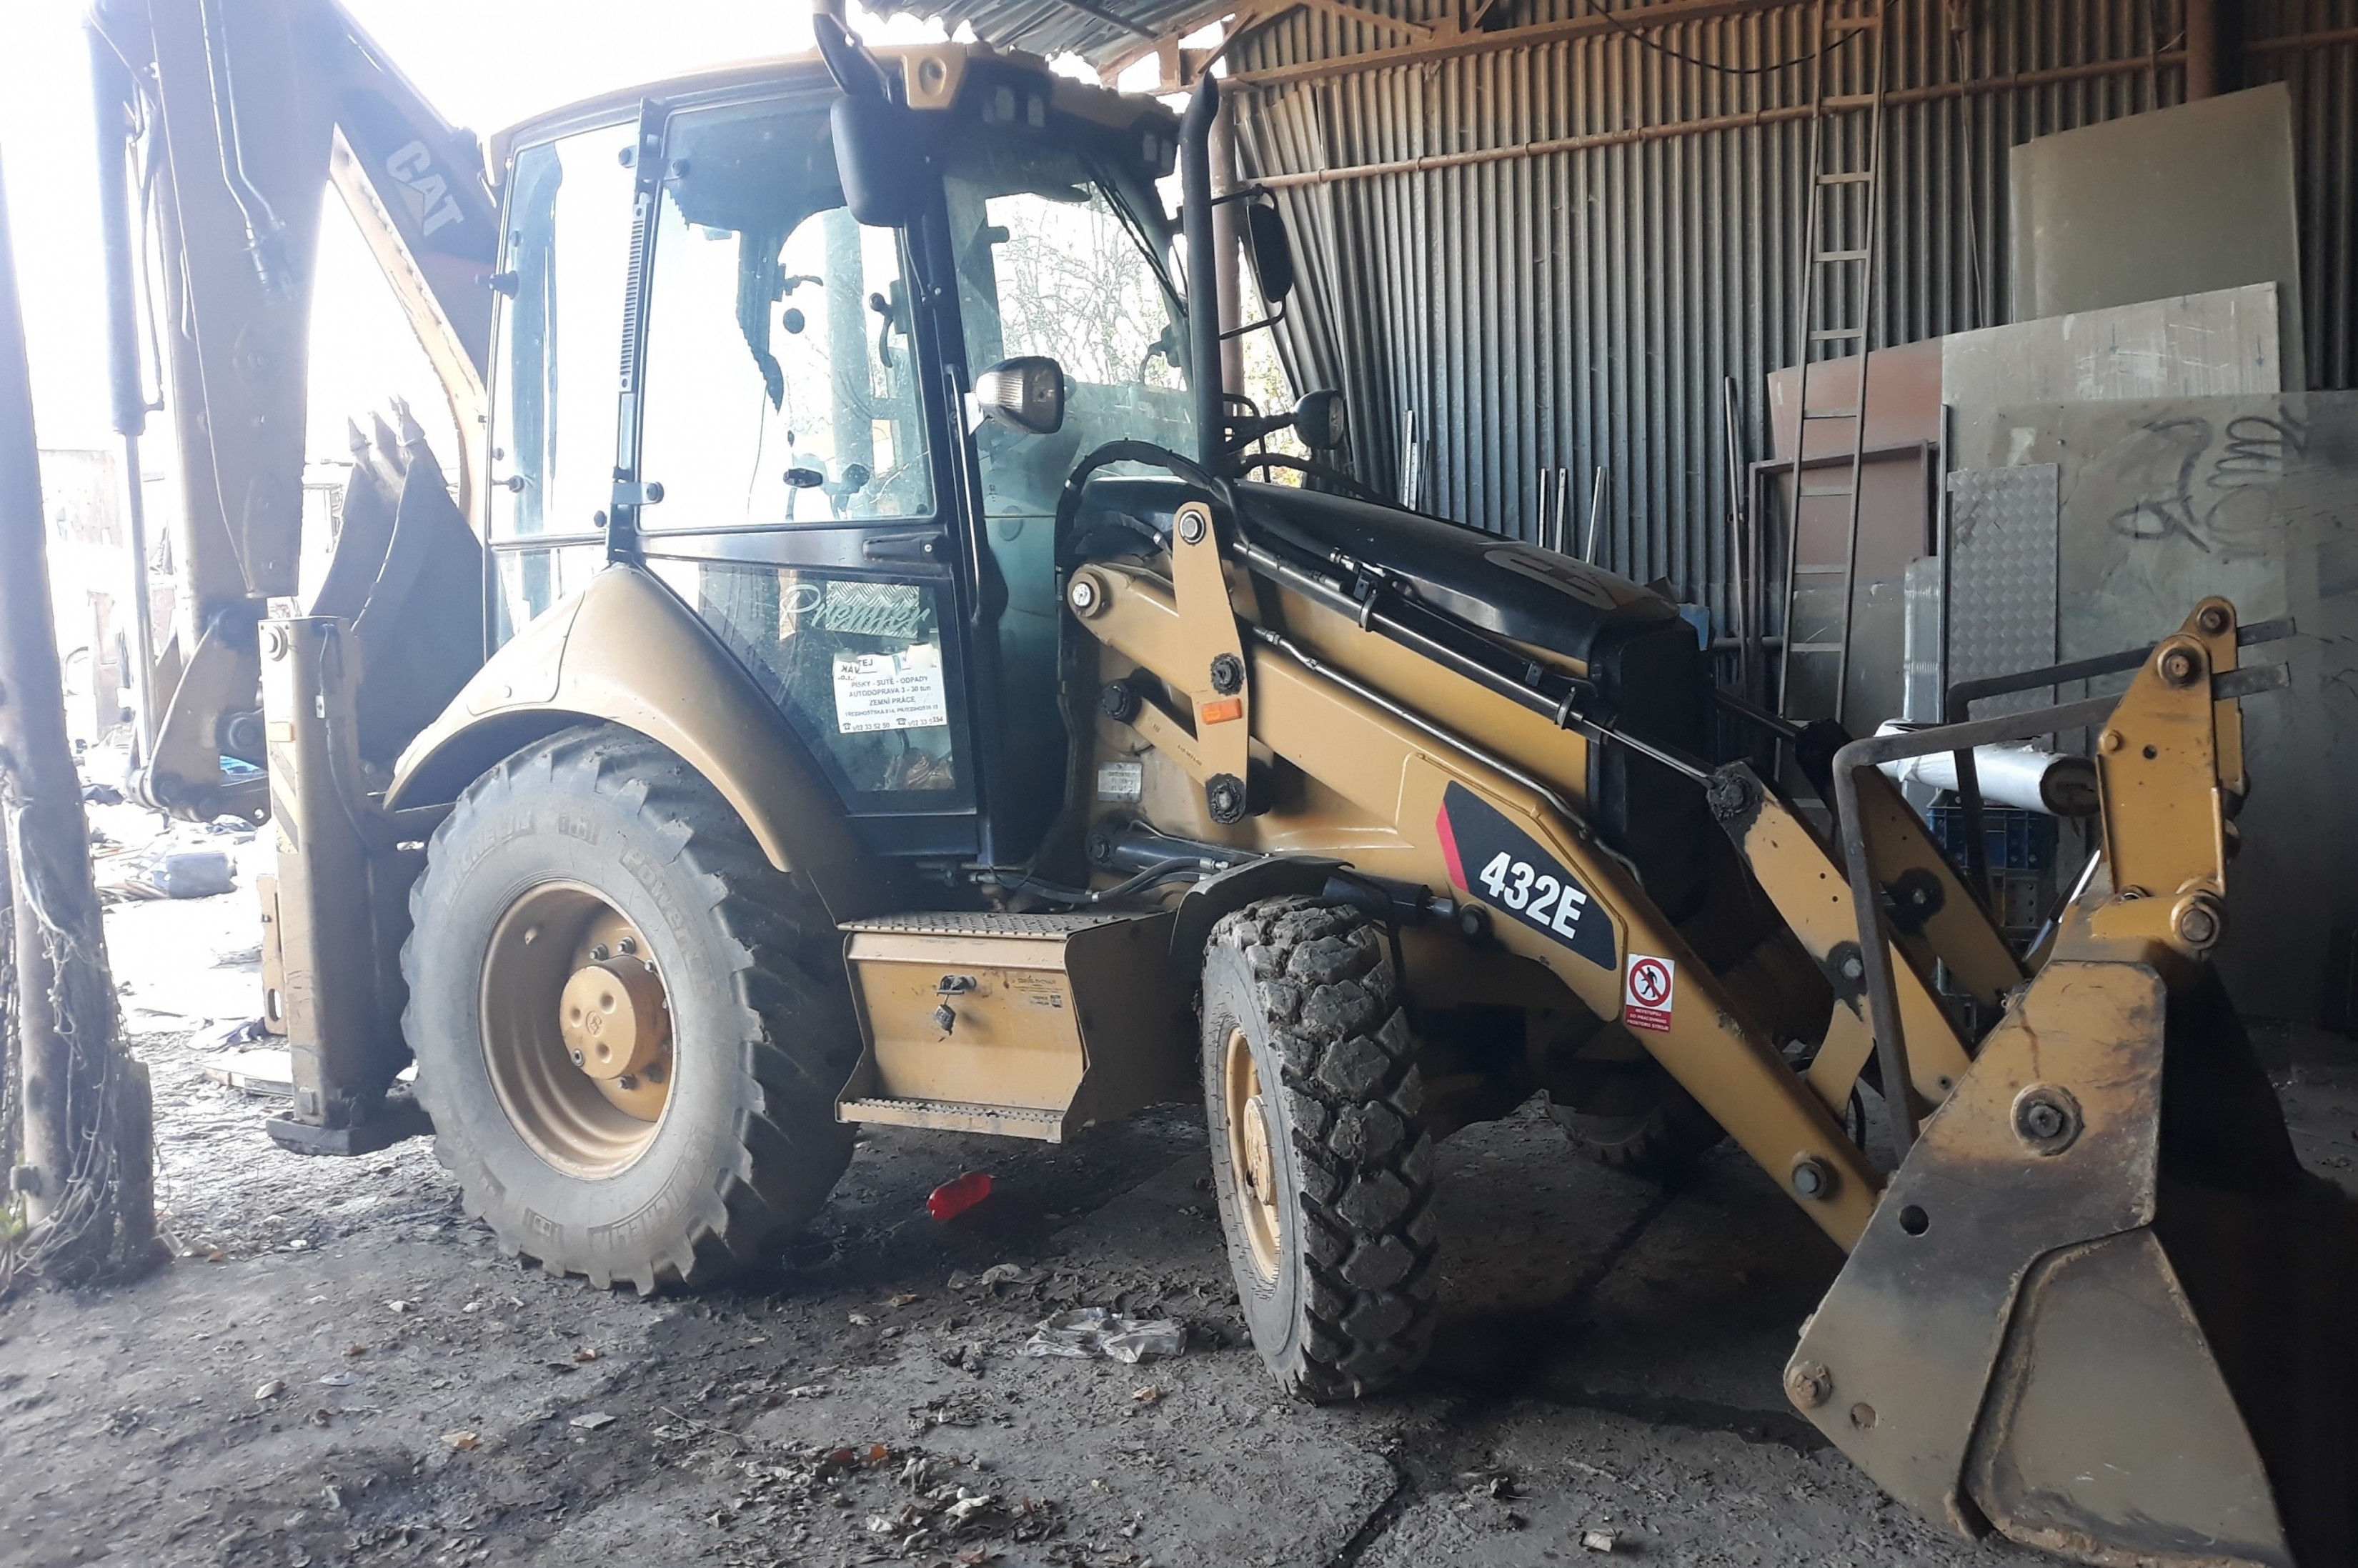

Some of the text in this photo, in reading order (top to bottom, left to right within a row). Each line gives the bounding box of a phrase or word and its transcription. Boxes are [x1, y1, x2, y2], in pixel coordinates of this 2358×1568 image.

[386, 140, 464, 236] CAT
[780, 584, 931, 631] Premier
[849, 688, 900, 697] AUTODOPRAVA
[869, 697, 890, 706] ZEMNÍ
[1479, 852, 1587, 940] 432E
